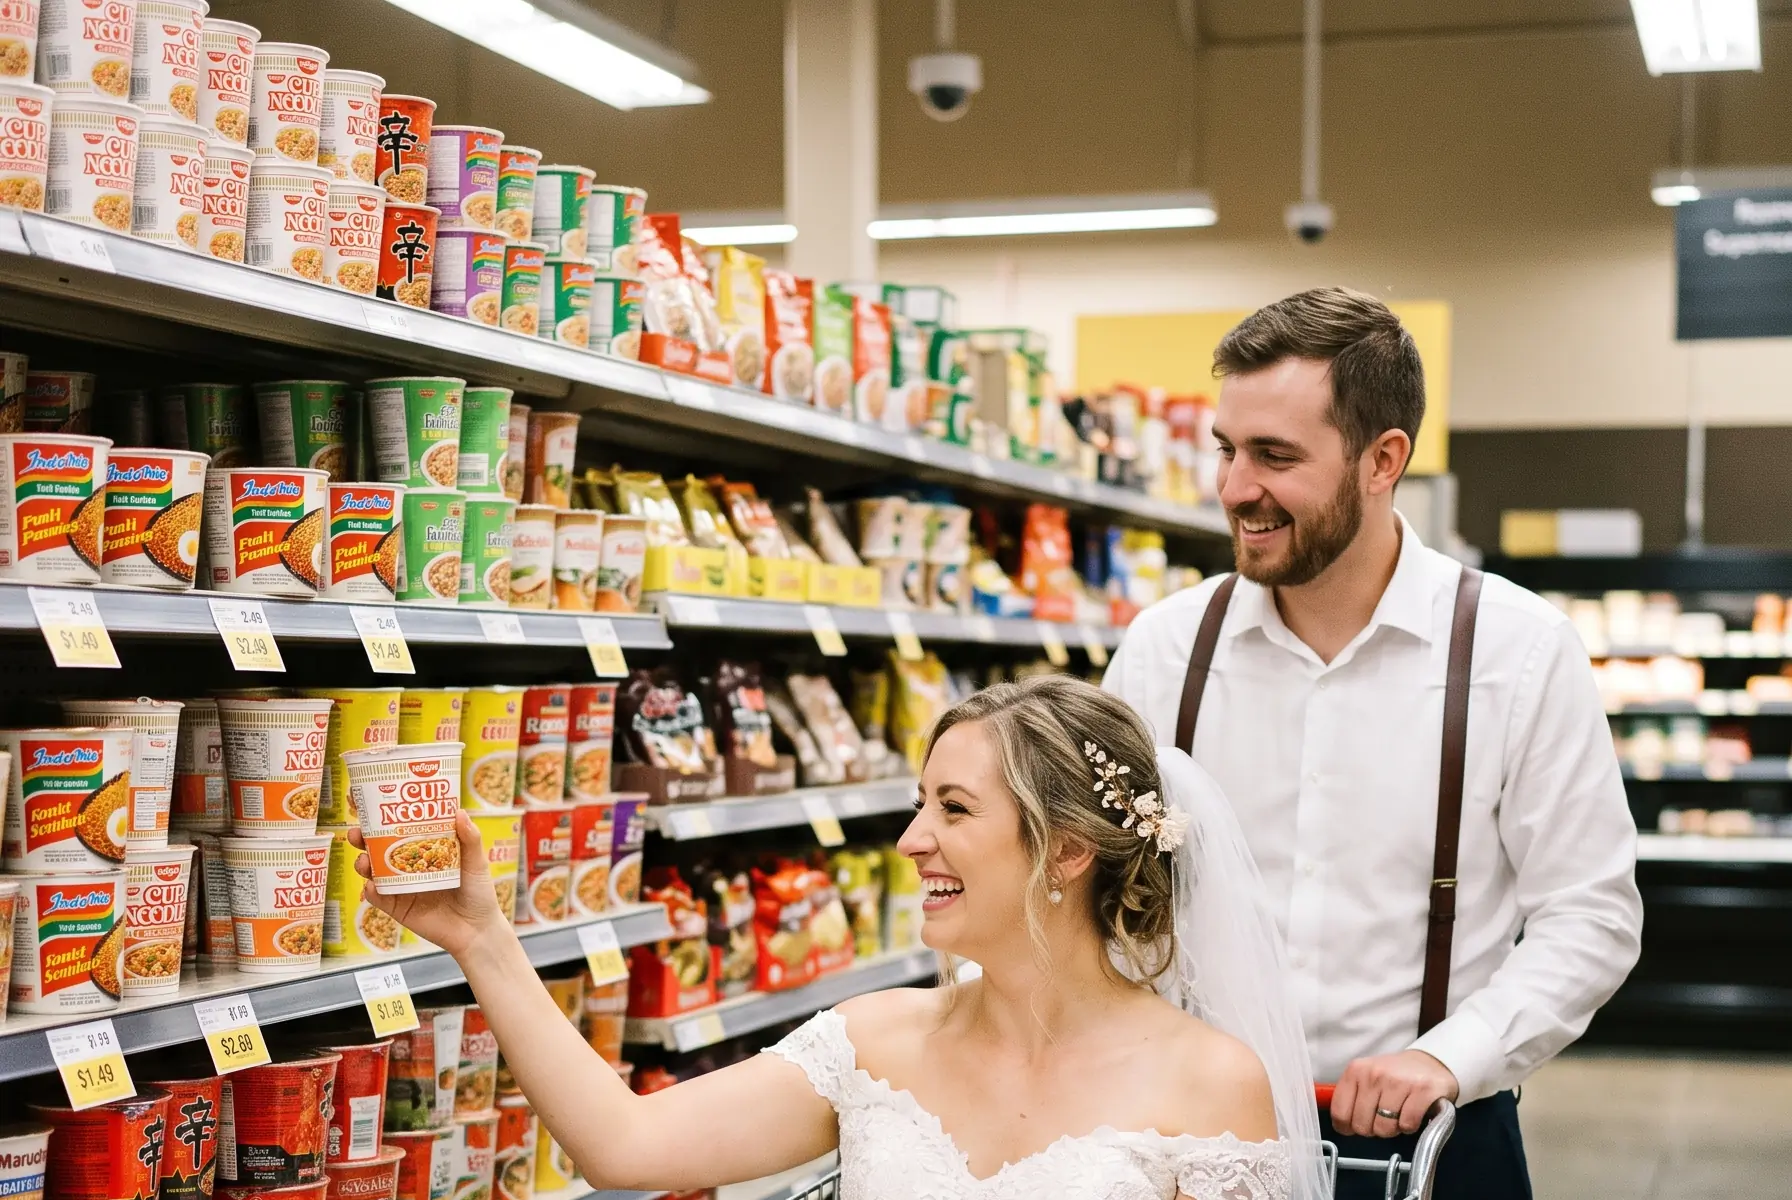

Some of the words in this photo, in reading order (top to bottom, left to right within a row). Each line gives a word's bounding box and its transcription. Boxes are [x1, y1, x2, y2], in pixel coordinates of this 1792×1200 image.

[401, 779, 451, 803] CUP
[143, 883, 186, 906] CUP
[77, 1063, 115, 1090] $1.49
